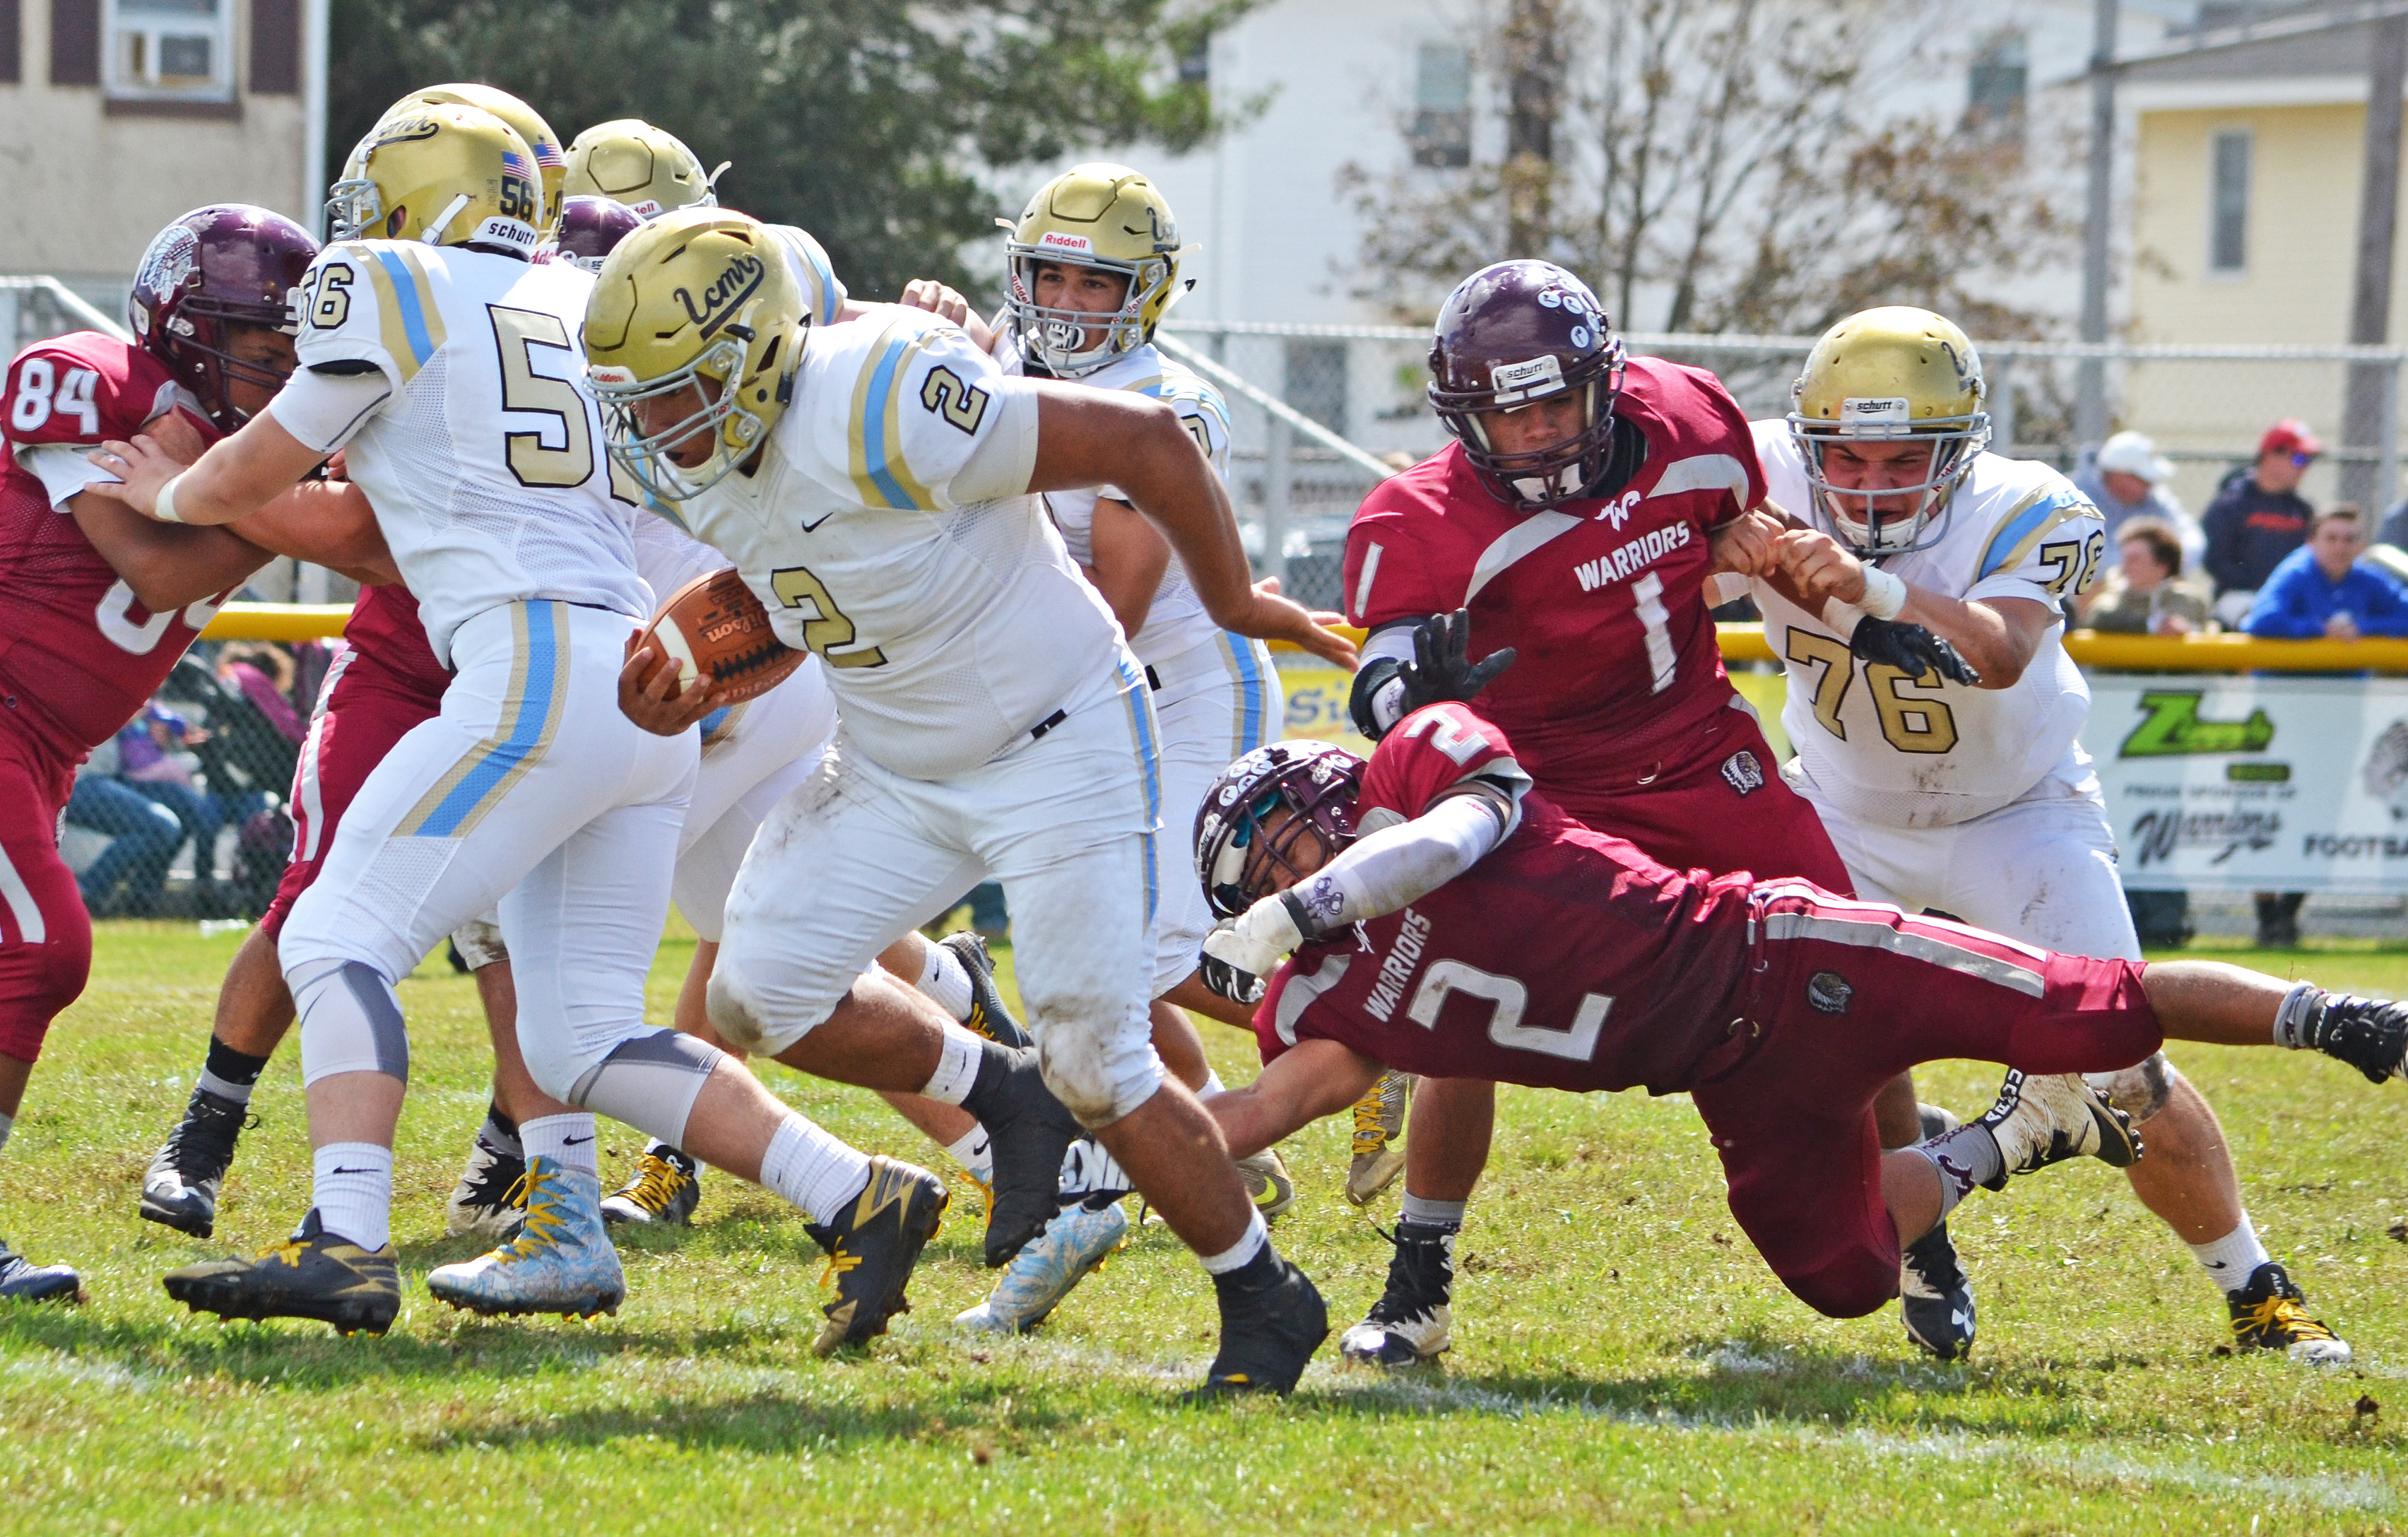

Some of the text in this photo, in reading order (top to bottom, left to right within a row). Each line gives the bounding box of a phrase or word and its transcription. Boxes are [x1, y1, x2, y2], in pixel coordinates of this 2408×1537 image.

[488, 222, 534, 245] schutt
[500, 175, 534, 222] 56
[1045, 234, 1086, 248] Riddell
[11, 358, 99, 435] 84
[921, 365, 990, 436] 2
[1506, 363, 1543, 378] schutt
[1856, 400, 1893, 410] schutt
[1354, 541, 1383, 618] 1
[1574, 519, 1690, 592] WARRIORS
[2037, 529, 2104, 596] 76
[771, 567, 888, 668] 2
[1631, 571, 1677, 695] 1
[1786, 626, 1959, 754] 76
[1403, 709, 1490, 767] 2
[1362, 907, 1432, 1023] WARRIORS
[1407, 958, 1615, 1061] 2
